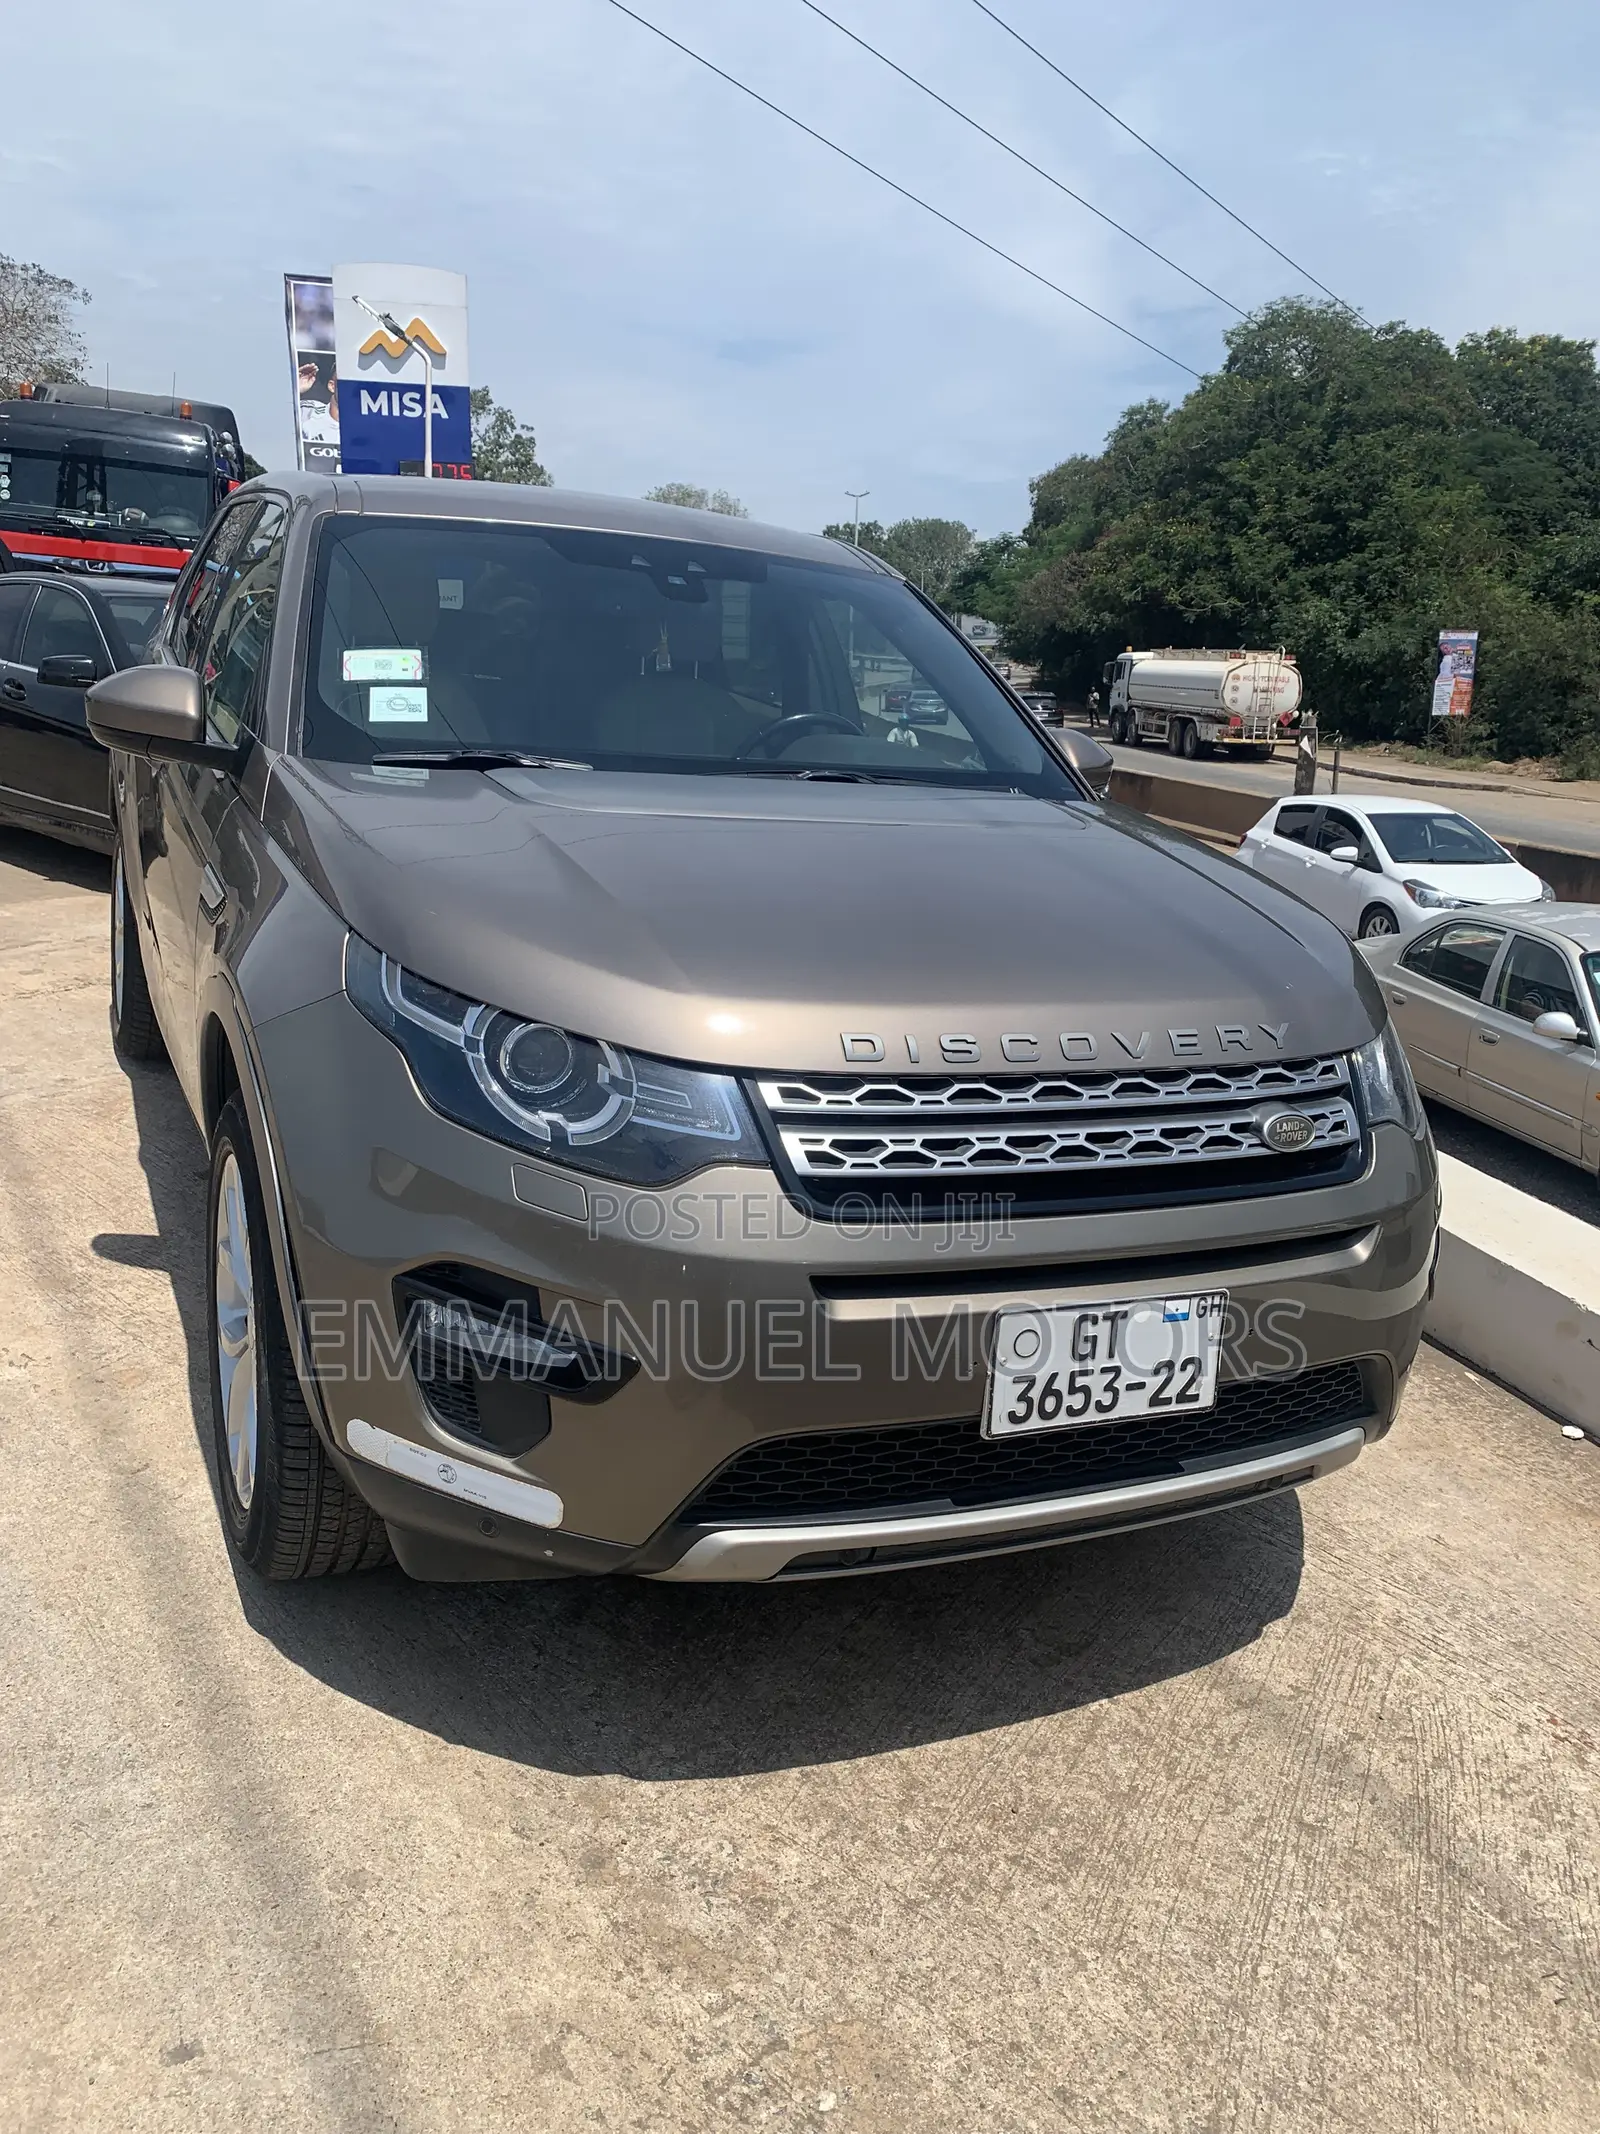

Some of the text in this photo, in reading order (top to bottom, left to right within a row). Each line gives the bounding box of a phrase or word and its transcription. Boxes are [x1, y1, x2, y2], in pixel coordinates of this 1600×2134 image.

[360, 389, 449, 419] MISA
[839, 1023, 1290, 1064] DISCOVERY
[1276, 1121, 1300, 1133] LAND
[1280, 1131, 1308, 1142] ROVER
[1195, 1295, 1224, 1319] GH
[1072, 1310, 1128, 1362] GT
[1007, 1356, 1204, 1425] 3653-22
